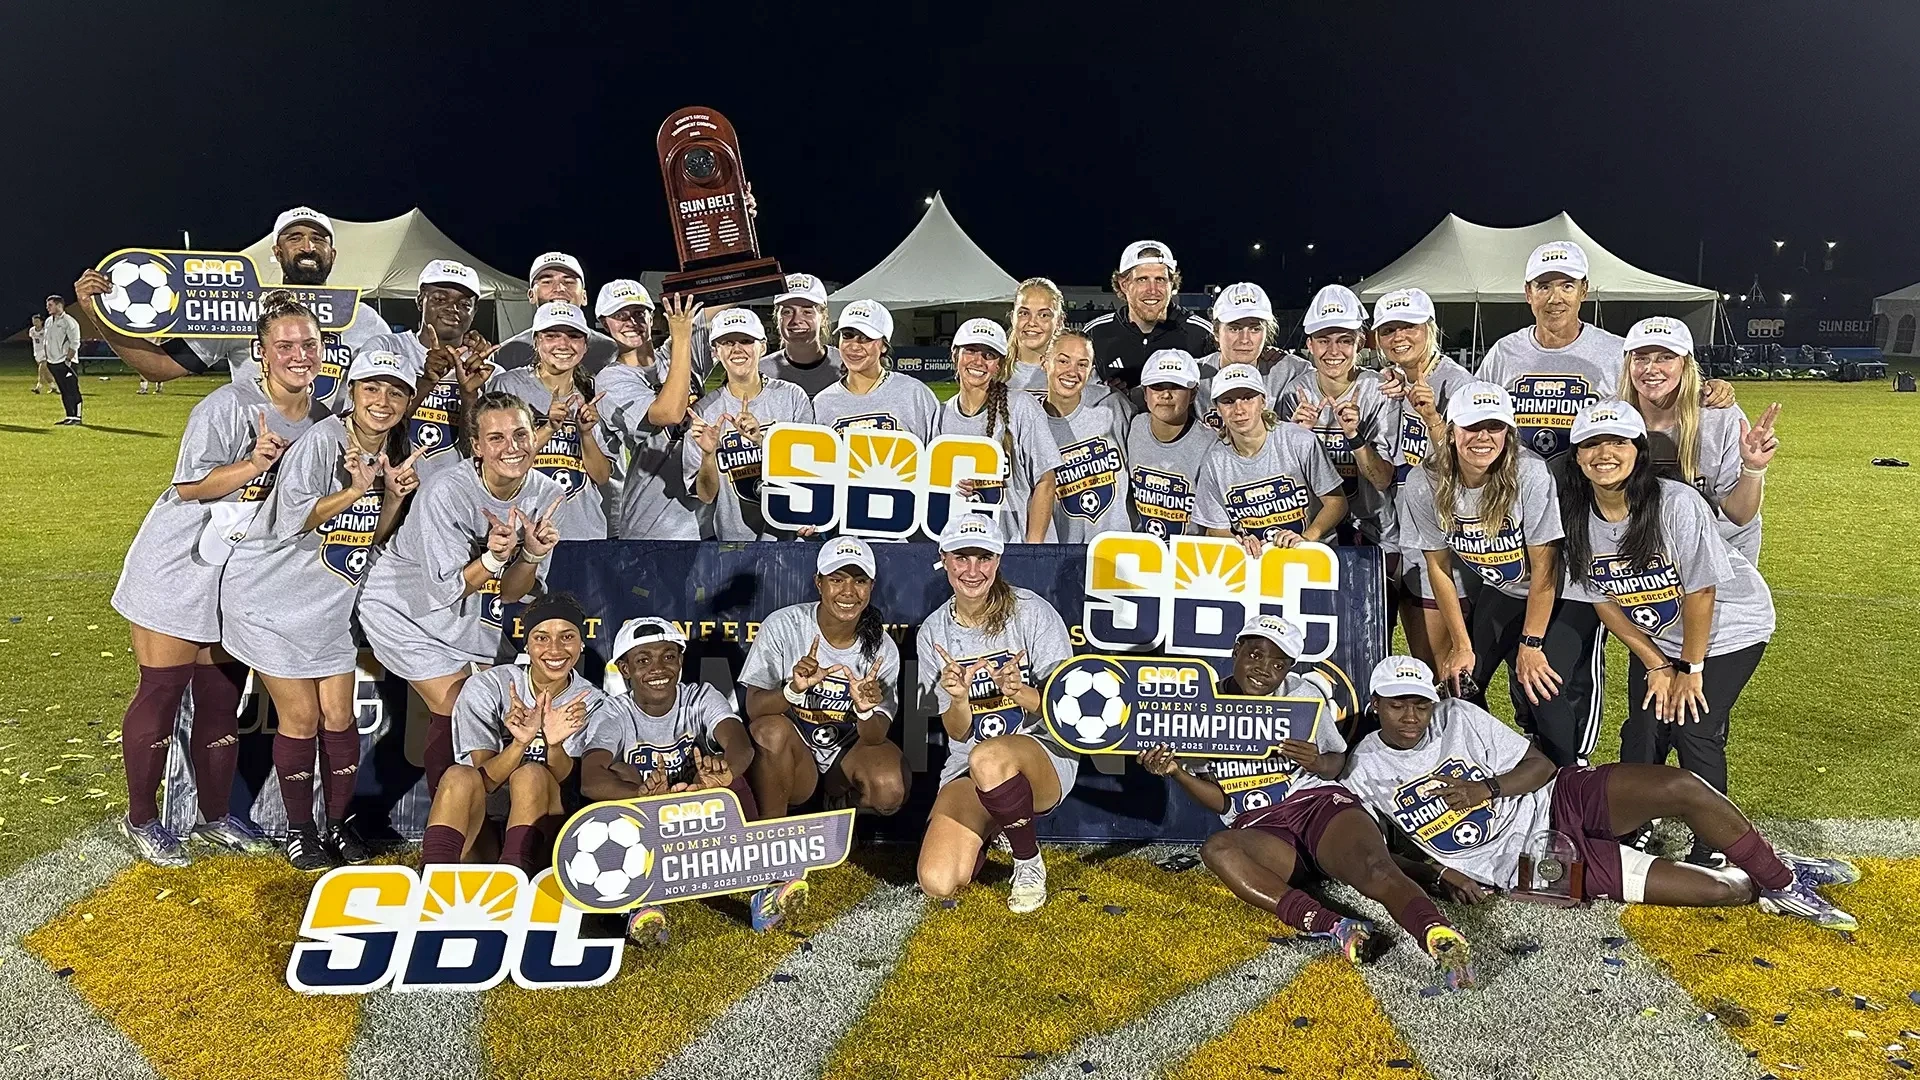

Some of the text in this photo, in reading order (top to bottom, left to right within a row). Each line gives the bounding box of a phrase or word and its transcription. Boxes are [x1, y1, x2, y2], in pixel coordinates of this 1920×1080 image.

[680, 193, 735, 214] SUN BELT
[183, 259, 245, 287] SBC
[186, 289, 254, 299] WOMEN'S
[1747, 319, 1785, 338] SBC
[1818, 320, 1872, 332] SUN BELT
[897, 358, 922, 371] SBC
[1520, 381, 1582, 397] 20 SBC 25
[1409, 425, 1420, 434] 25
[1516, 417, 1548, 425] WOMEN'S
[727, 439, 738, 448] 20
[1094, 445, 1105, 454] 25
[1056, 452, 1120, 485] HAMPIONS
[761, 422, 1004, 541] SBC
[1145, 474, 1171, 494] SBC
[1173, 484, 1183, 493] 25
[1232, 484, 1290, 505] 20 SBC 25
[1226, 489, 1309, 522] CHAMPIONS
[1273, 511, 1302, 522] SOCCER
[330, 534, 366, 543] WOMEN'S
[1488, 552, 1520, 563] SOCCER
[1594, 567, 1606, 576] 20
[1083, 530, 1340, 663] SBC
[1641, 590, 1675, 601] SOCCER
[1137, 666, 1199, 698] SBC
[1138, 701, 1274, 715] WOMEN'S SOCCER
[1136, 712, 1291, 741] CHAMPIONS
[1181, 742, 1204, 750] 2025
[1212, 743, 1243, 752] FOLEY,
[1246, 744, 1259, 752] AL
[634, 755, 647, 764] 20
[1401, 766, 1464, 807] 20 25
[657, 798, 727, 840] SBC
[1421, 814, 1455, 838] WOMEN'S
[661, 825, 806, 854] WOMEN'S SOCCER
[661, 835, 827, 882] CHAMPIONS
[665, 870, 796, 896] NOV. 3-8, 2025 FOLEY, AL
[286, 864, 626, 995] SBC
